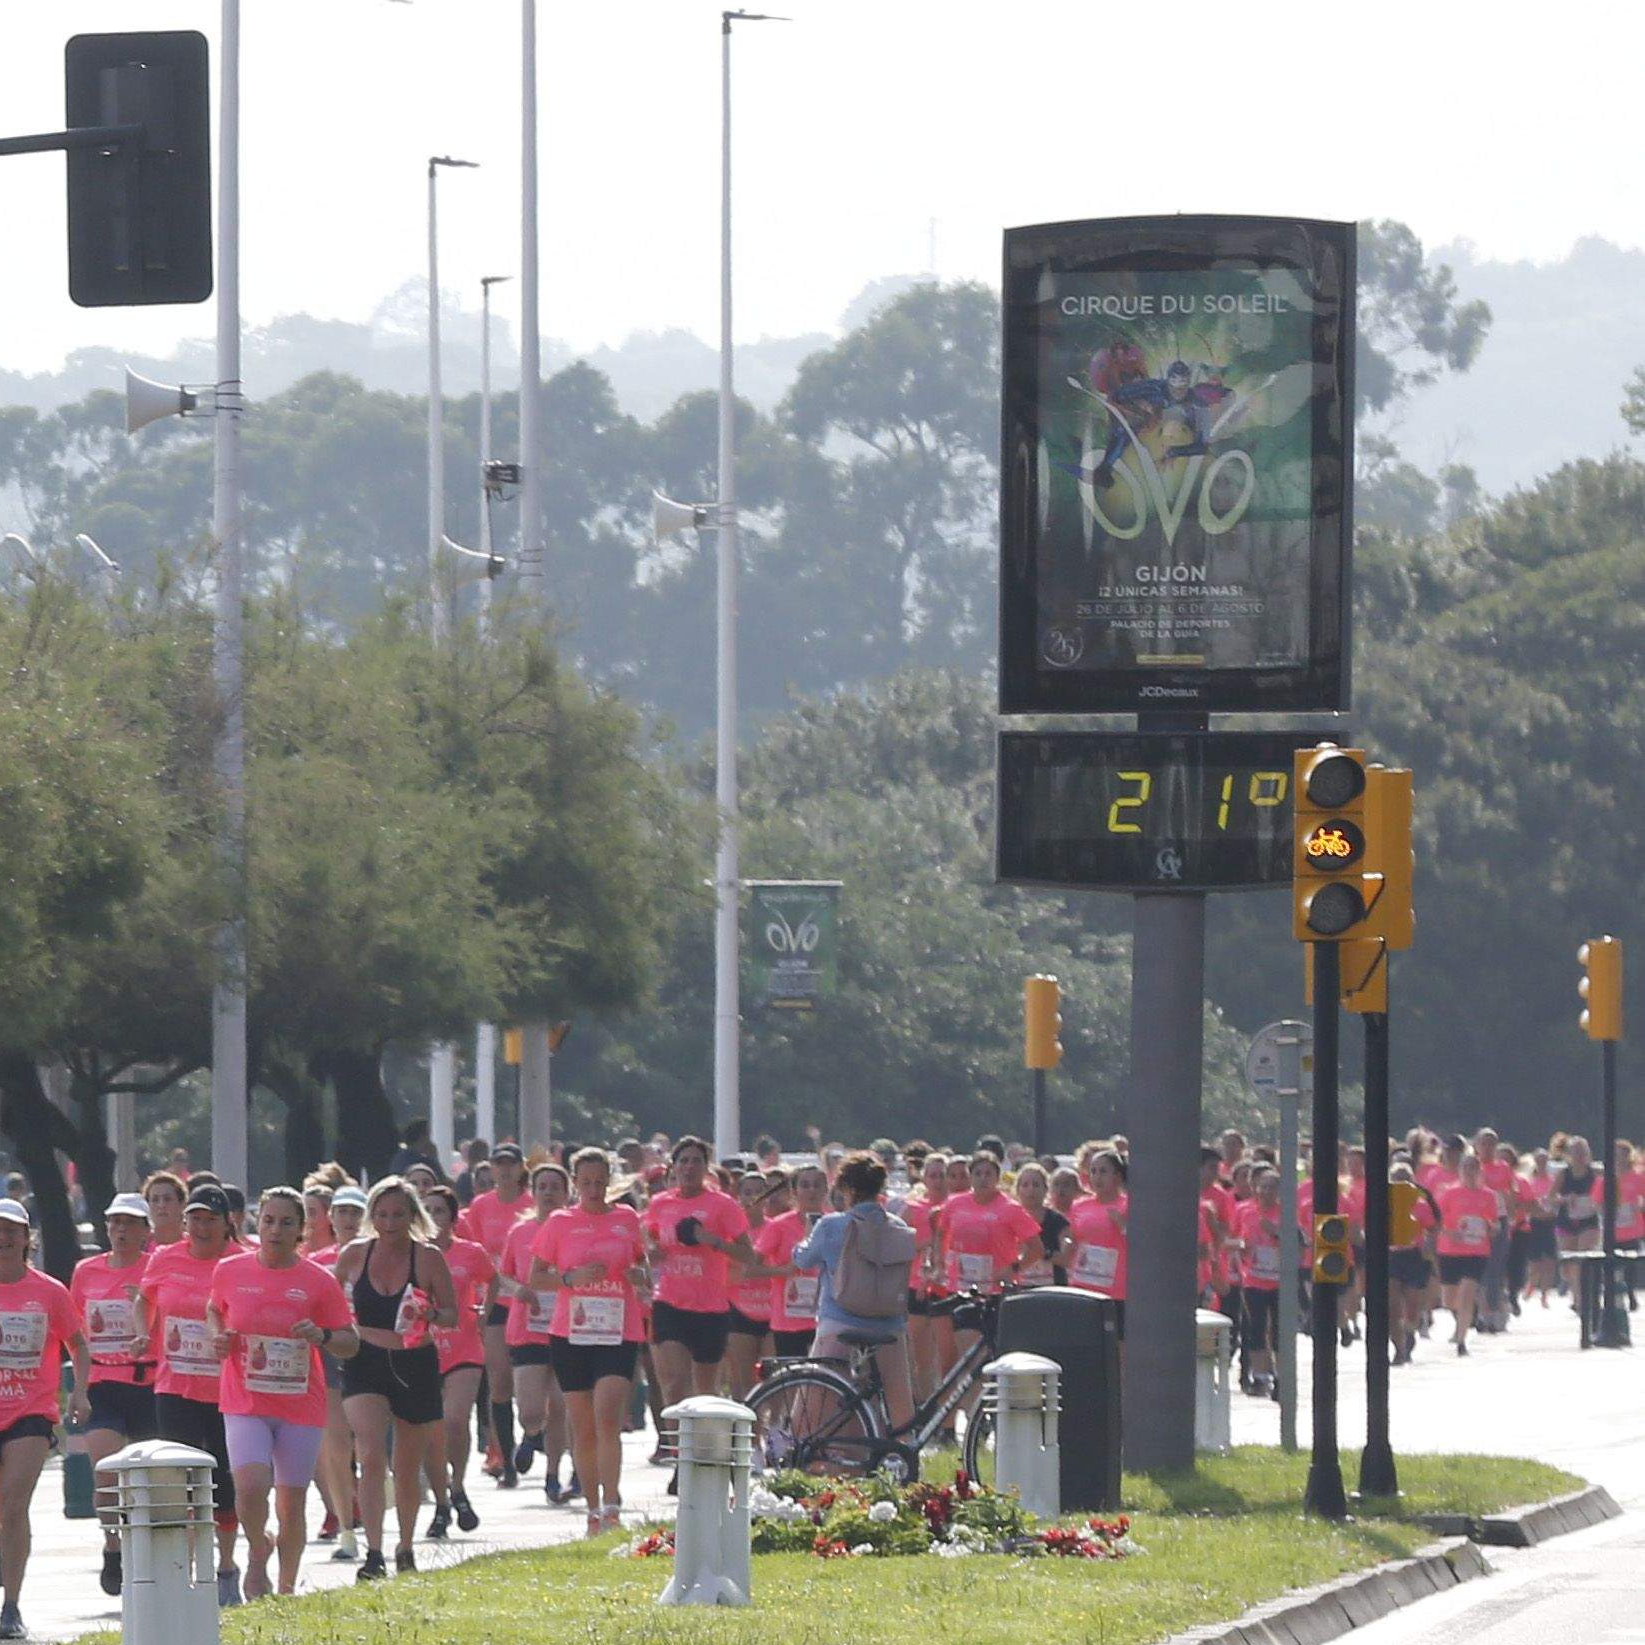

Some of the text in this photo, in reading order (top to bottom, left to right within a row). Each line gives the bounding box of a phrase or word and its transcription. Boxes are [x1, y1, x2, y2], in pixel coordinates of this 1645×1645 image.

[1061, 295, 1288, 320] CIRQUE DU SOLEIL
[1136, 562, 1207, 582] GIJÓN
[1172, 585, 1243, 597] SEMANAS!
[1076, 604, 1091, 615] 26
[1096, 604, 1111, 614] DE
[1117, 604, 1153, 614] JULIO
[1178, 604, 1185, 614] 6
[1190, 603, 1206, 614] DE
[1213, 603, 1265, 614] AGOSTO
[1175, 619, 1231, 629] DEPORTES
[1138, 686, 1199, 698] JCDecaux
